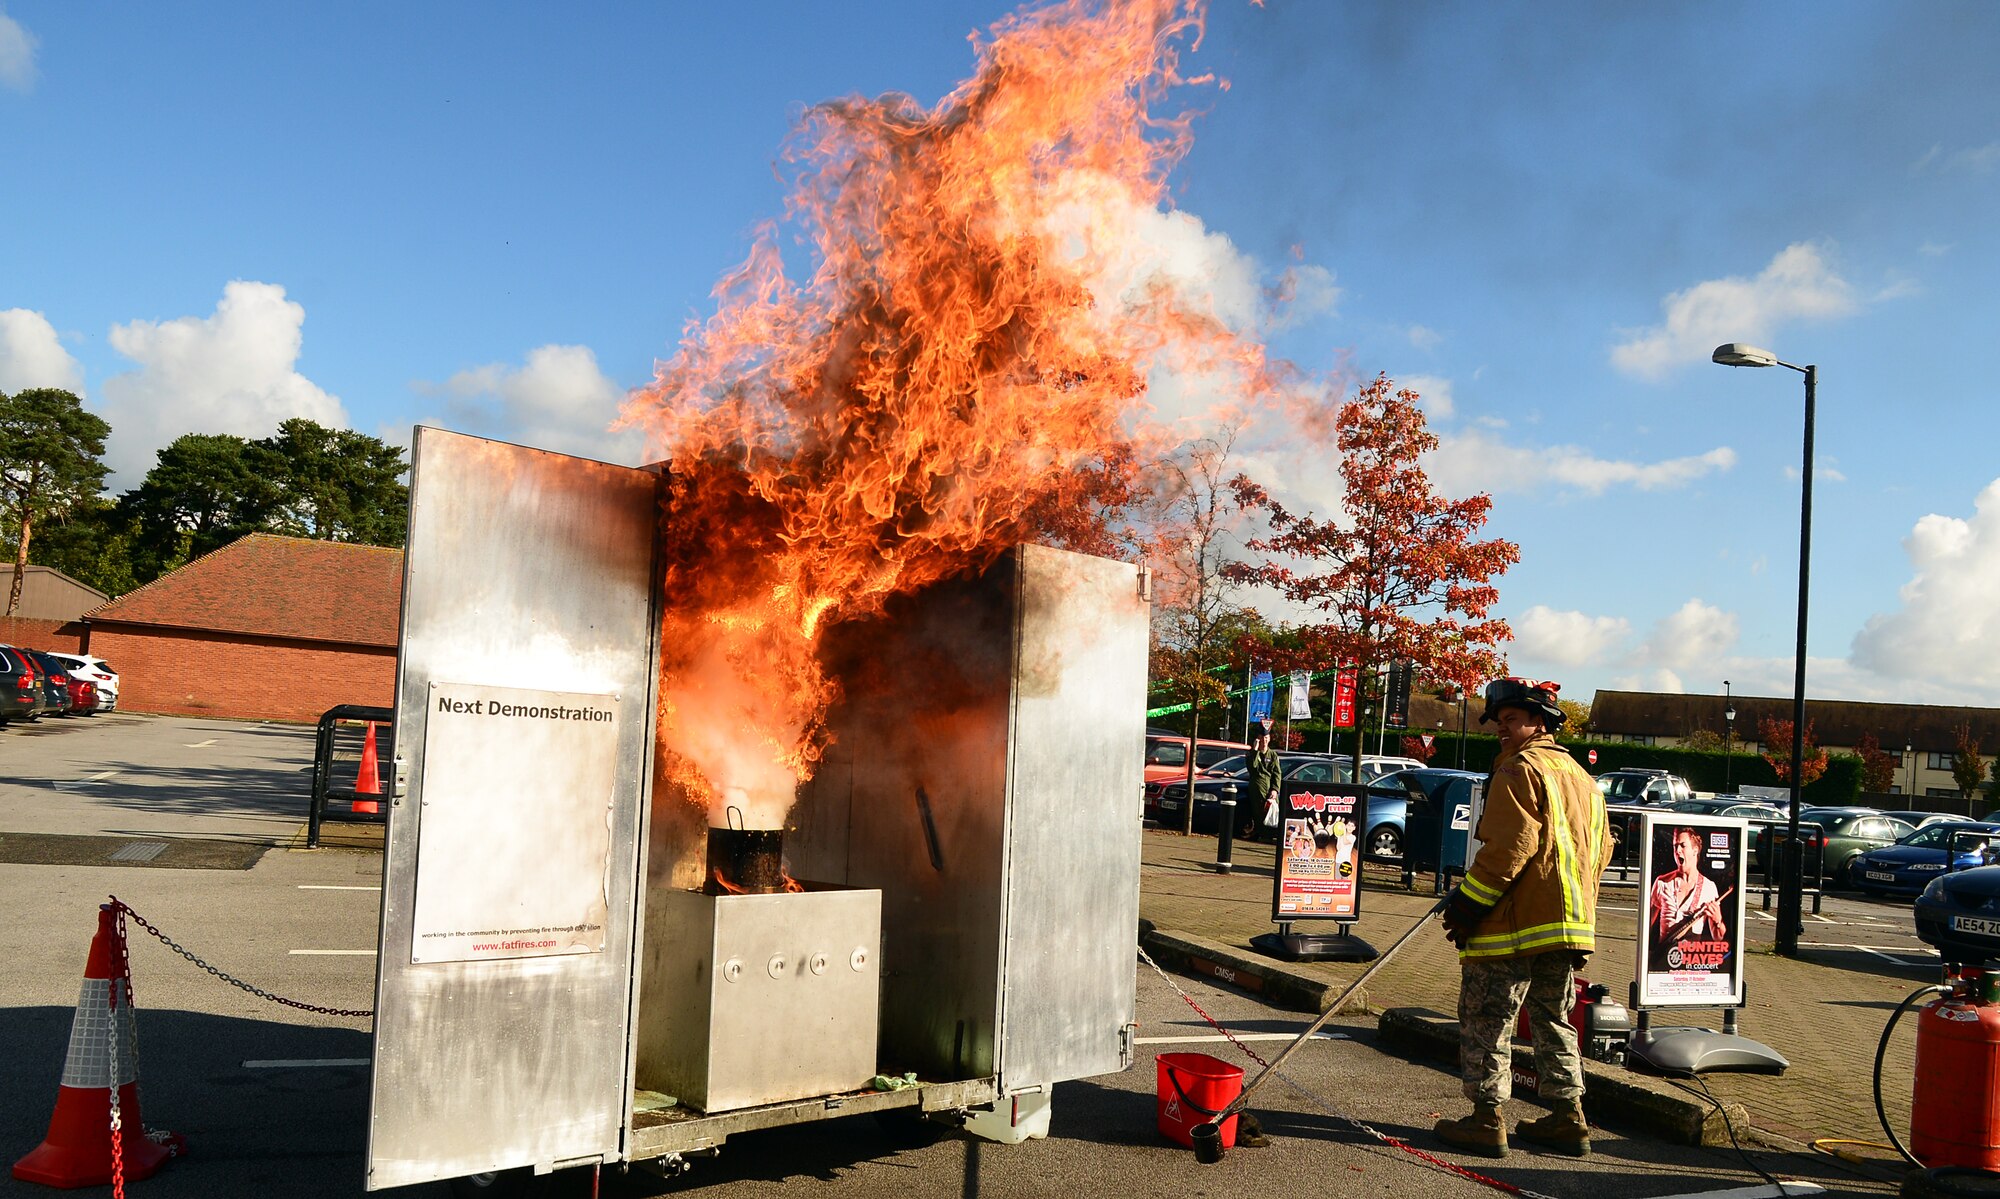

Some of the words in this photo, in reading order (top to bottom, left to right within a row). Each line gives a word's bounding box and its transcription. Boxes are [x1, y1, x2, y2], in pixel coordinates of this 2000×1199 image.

[438, 697, 483, 715] Next
[488, 700, 613, 722] Demonstration
[1325, 796, 1356, 804] KICK-OFF
[1329, 805, 1352, 813] EVENT!
[1956, 917, 1985, 932] AE54
[467, 929, 500, 937] community
[509, 927, 540, 935] preventing
[552, 925, 574, 933] through
[472, 939, 557, 951] www.fatfires.com
[1677, 941, 1729, 952] HUNTER
[1682, 953, 1724, 965] HAYES
